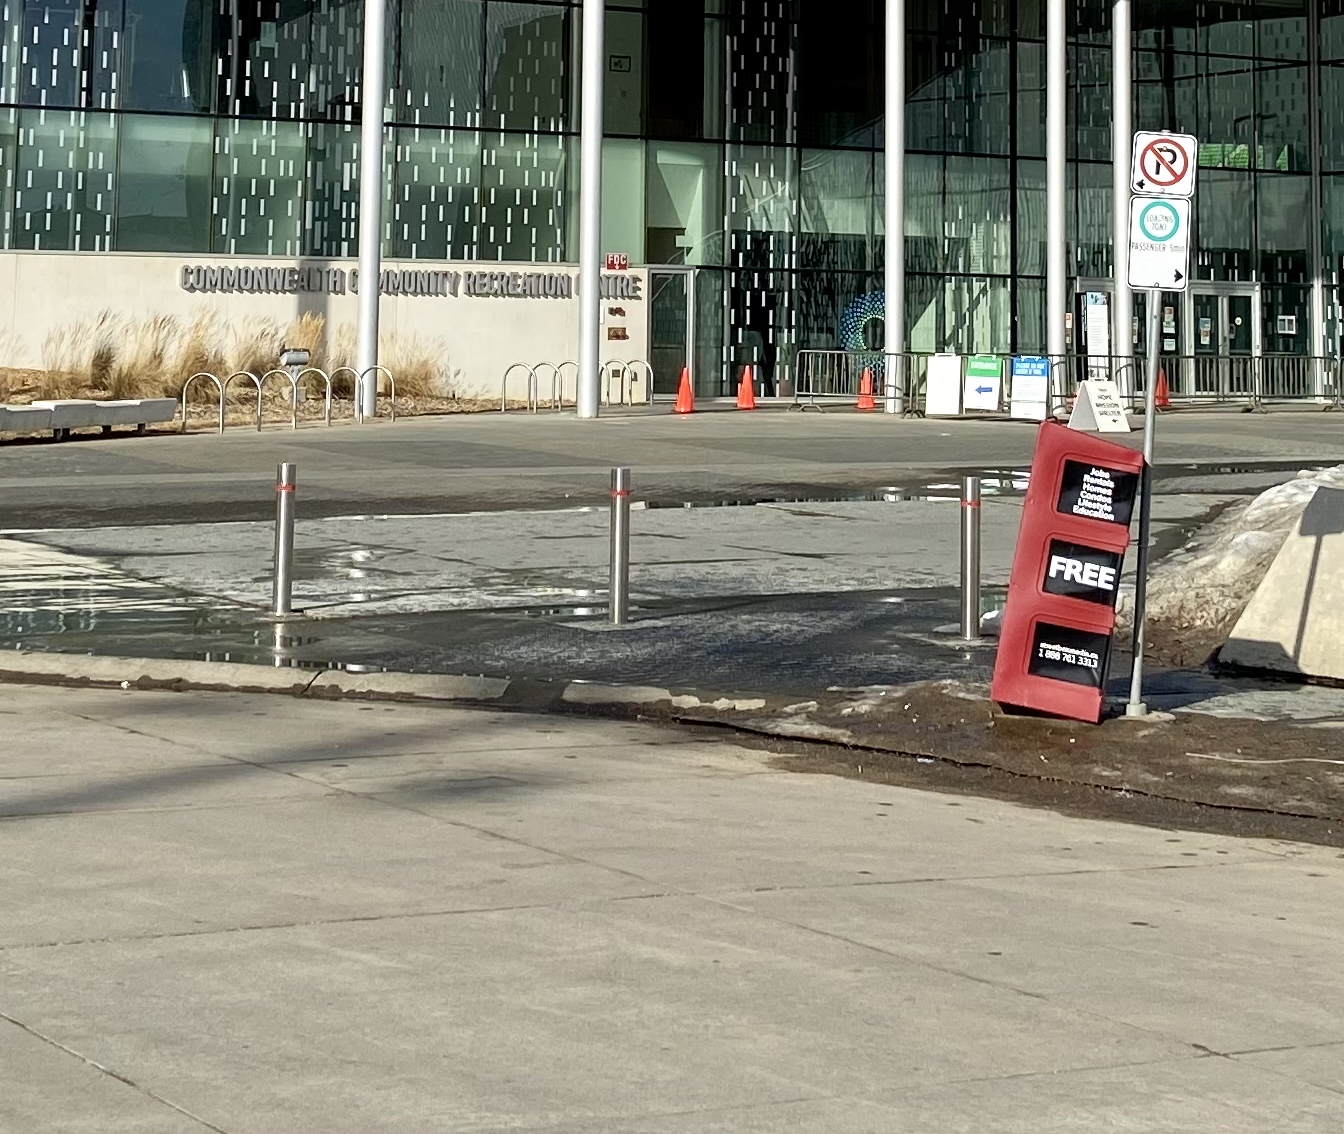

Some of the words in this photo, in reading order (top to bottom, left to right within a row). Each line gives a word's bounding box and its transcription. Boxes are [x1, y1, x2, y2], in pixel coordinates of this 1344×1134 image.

[607, 253, 627, 265] FDC
[179, 264, 346, 296] COMMONWEALTH
[463, 269, 573, 300] RECREATION
[1083, 473, 1114, 488] Rentals
[1090, 467, 1110, 479] Jobs
[1083, 482, 1112, 496] Homes
[1079, 491, 1112, 504] Condos
[1072, 504, 1115, 521] Education
[1077, 498, 1113, 513] Lifestyle
[1048, 555, 1116, 591] FREE
